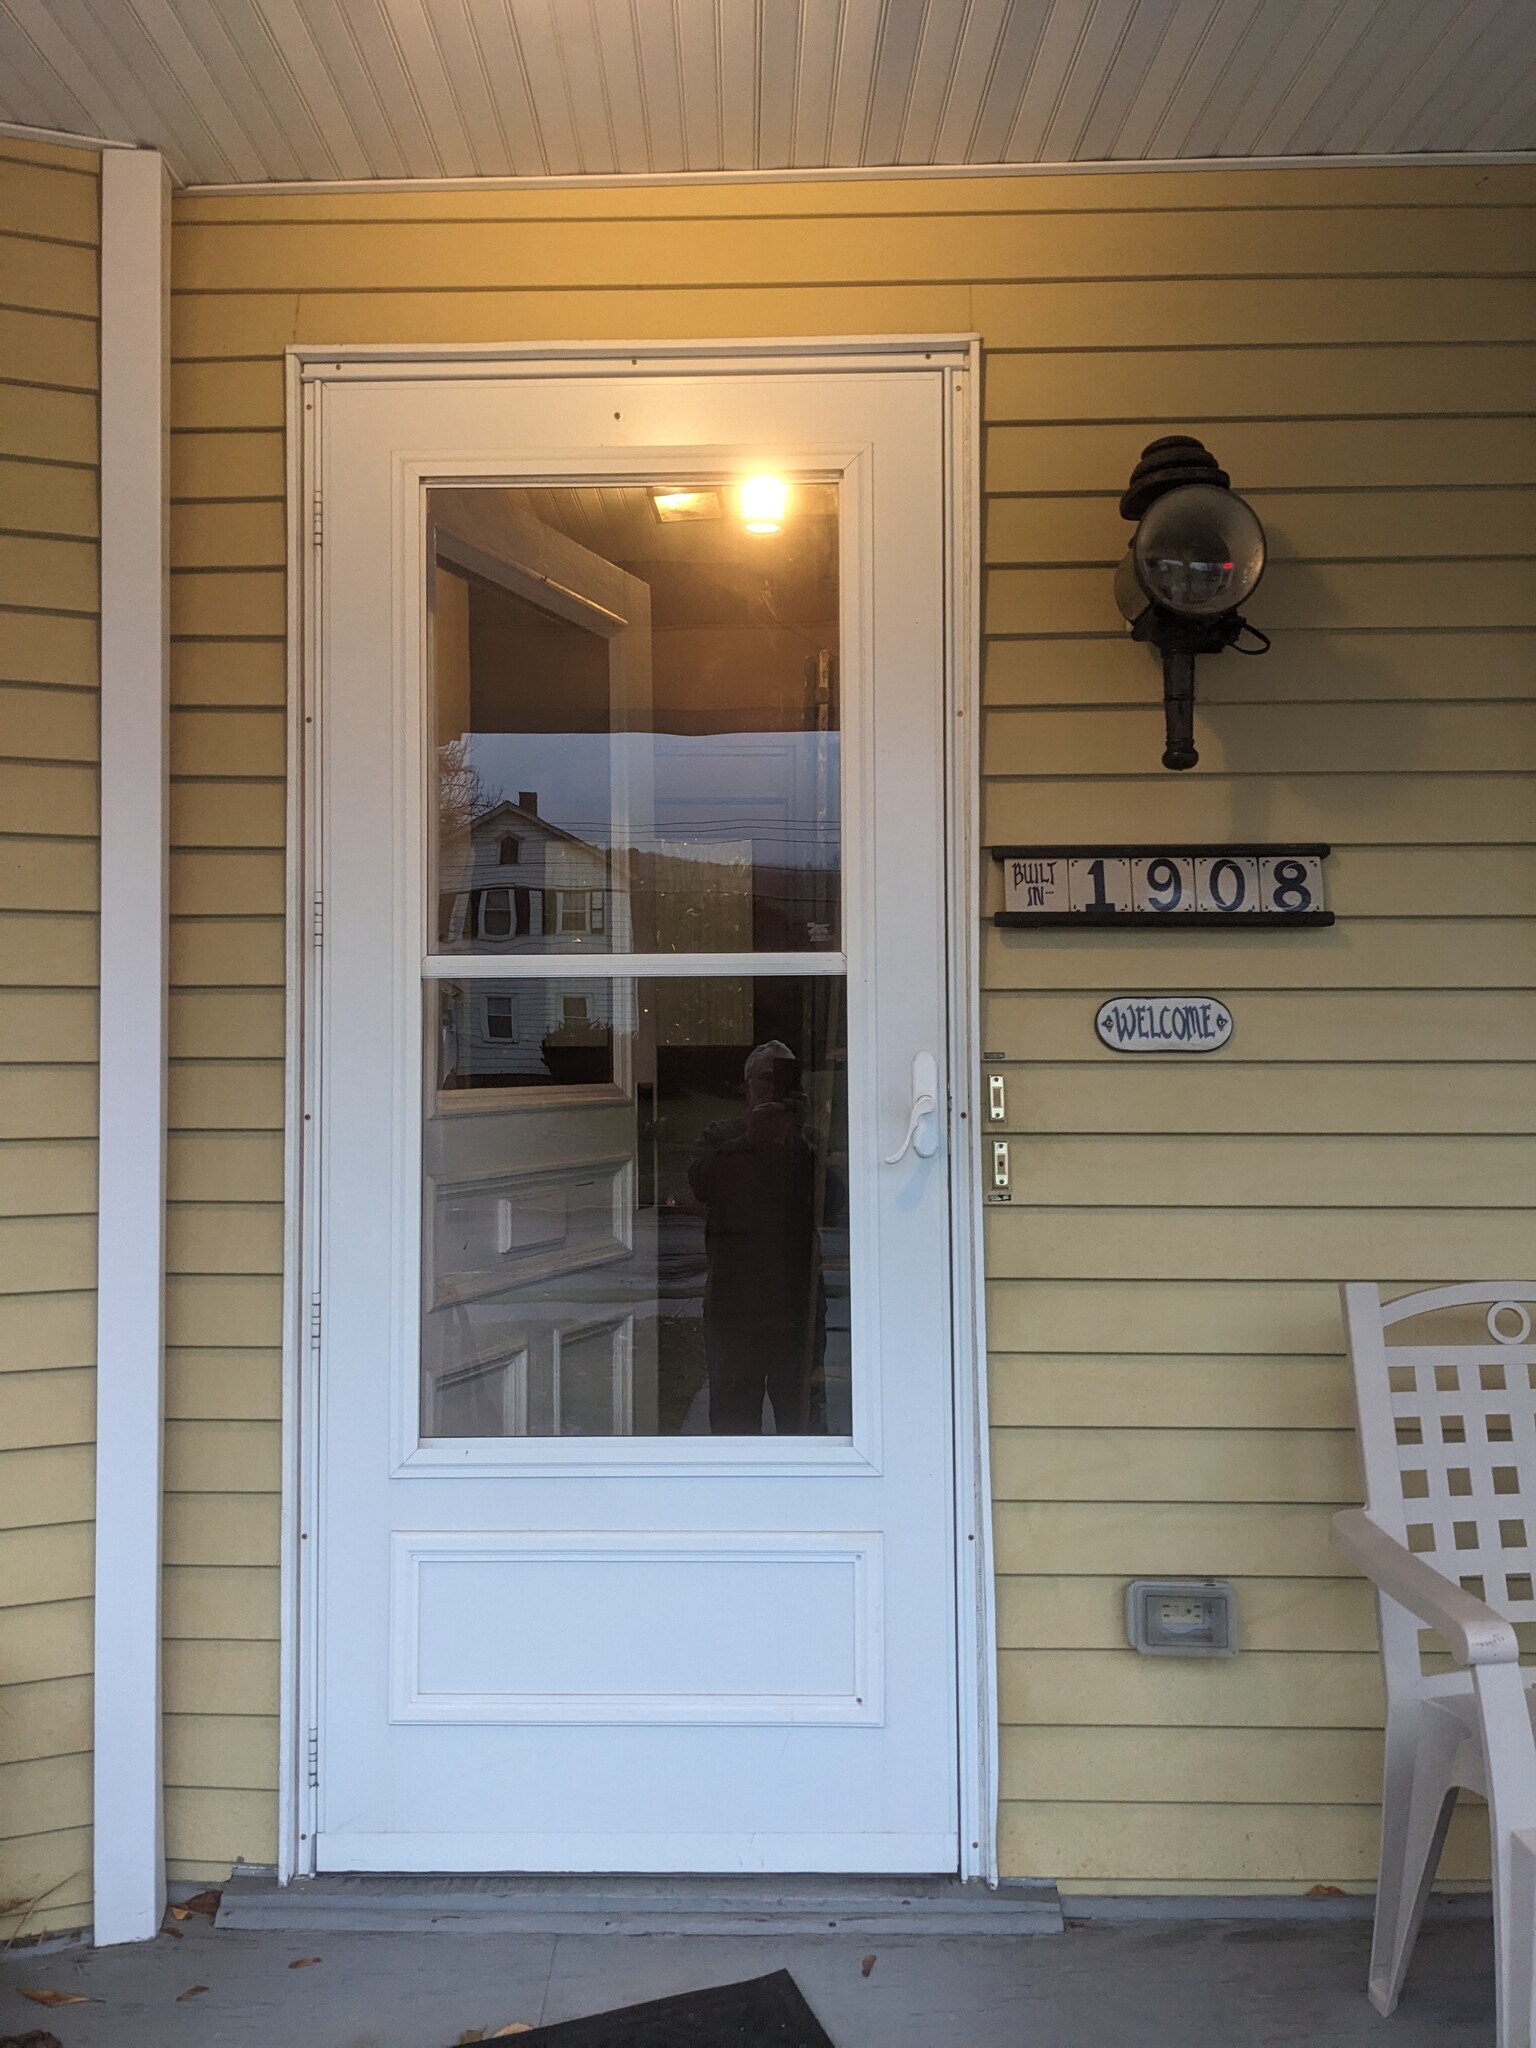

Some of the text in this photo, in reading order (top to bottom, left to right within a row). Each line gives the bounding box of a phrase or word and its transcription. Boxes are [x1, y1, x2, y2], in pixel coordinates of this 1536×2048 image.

[1012, 861, 1057, 891] BUILT
[1085, 858, 1312, 913] 1908
[1112, 1004, 1216, 1042] WELCOME
